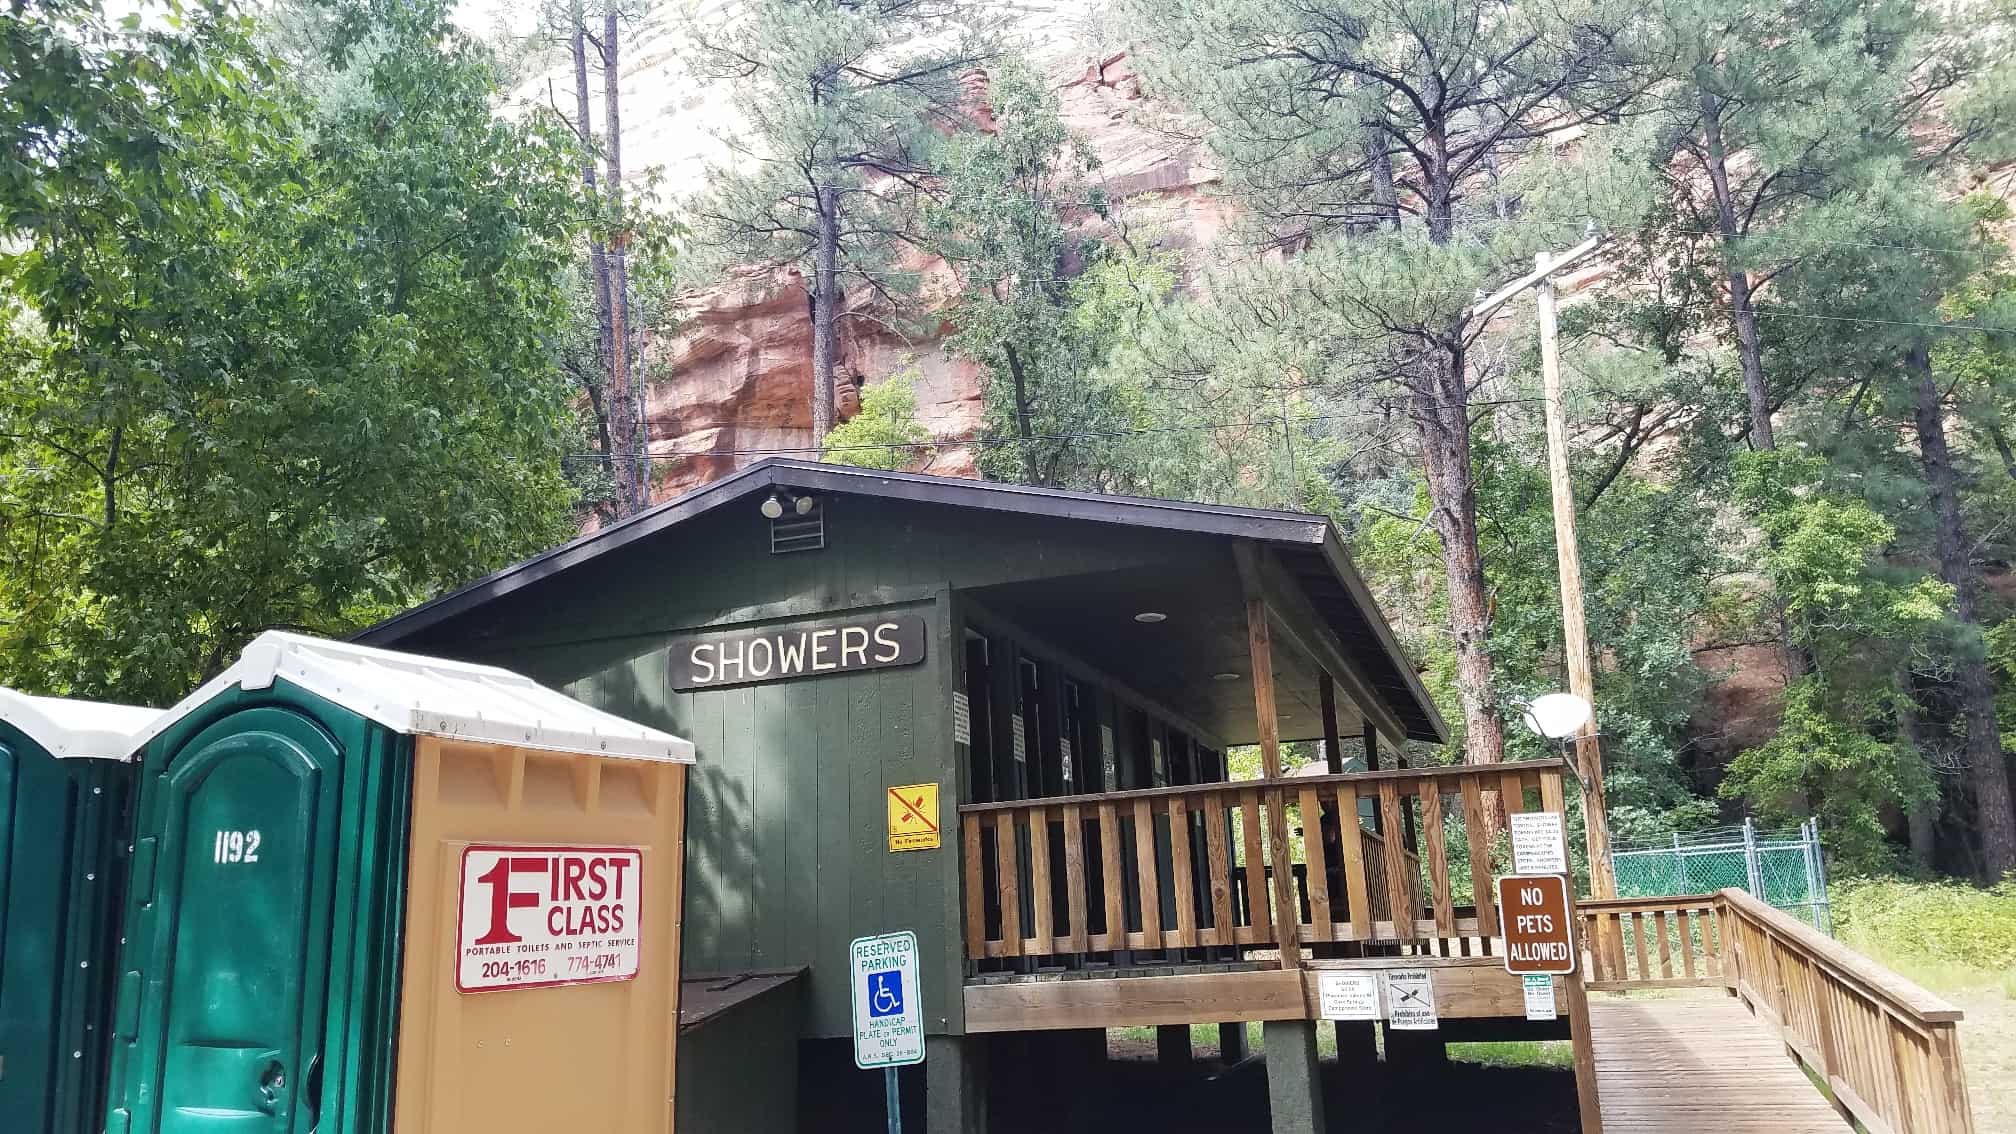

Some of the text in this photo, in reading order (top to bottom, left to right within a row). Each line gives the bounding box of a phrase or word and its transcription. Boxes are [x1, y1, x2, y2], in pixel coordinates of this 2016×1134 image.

[690, 623, 900, 682] SHOWERS
[214, 830, 261, 864] 1192
[1520, 887, 1543, 906] NO
[547, 904, 624, 936] CLASS
[1517, 914, 1553, 934] PETS
[466, 938, 636, 956] PORTABLE TOILETS AND SEPTIC SERVICE
[856, 940, 911, 959] RESERVED
[1510, 942, 1568, 961] ALLOWED
[482, 958, 546, 978] 204-1616
[567, 953, 622, 972] 774-4741
[861, 955, 907, 972] PARKING
[860, 1030, 881, 1040] PLATE
[892, 1025, 920, 1037] PERMIT
[869, 1017, 906, 1029] HANDICAP
[880, 1038, 897, 1048] ONLY
